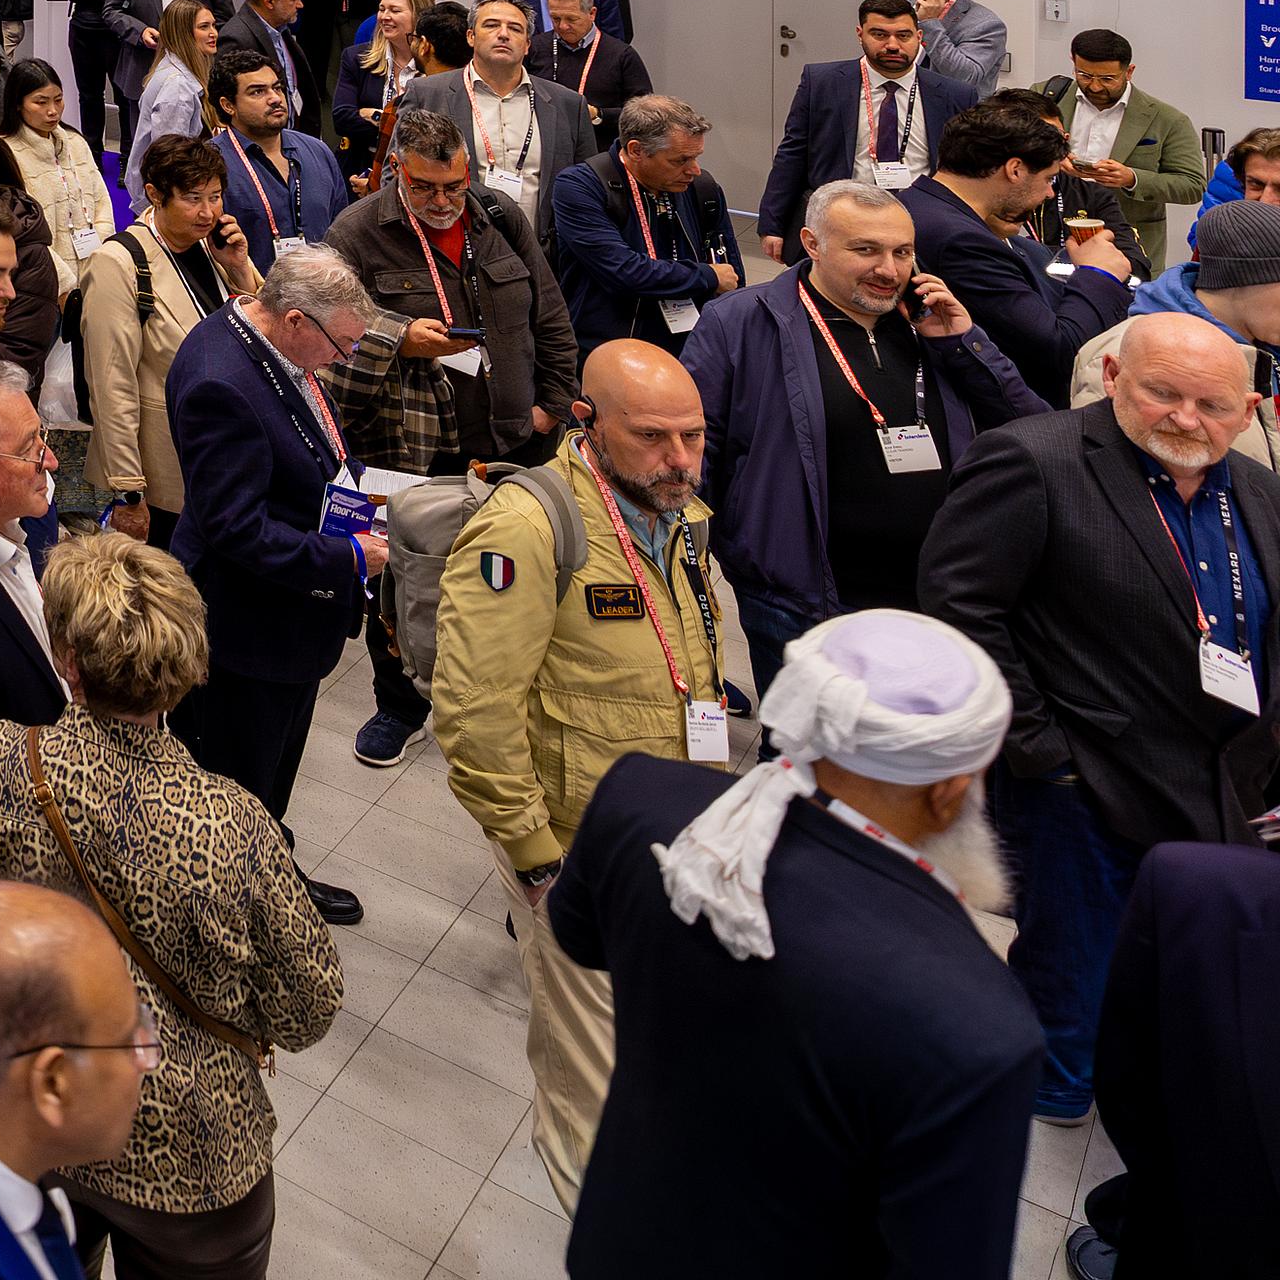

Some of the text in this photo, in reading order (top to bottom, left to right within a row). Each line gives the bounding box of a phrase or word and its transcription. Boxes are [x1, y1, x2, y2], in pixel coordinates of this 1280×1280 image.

[1259, 64, 1272, 73] for
[228, 314, 253, 344] NEXARO
[262, 361, 285, 396] NEXARO
[330, 503, 369, 522] Floor Plan
[1217, 490, 1232, 527] NEXA
[681, 516, 698, 566] NEXARO
[1229, 552, 1243, 600] NEXARO
[601, 606, 635, 615] LEADER
[629, 589, 637, 601] 1
[698, 594, 717, 645] NEXARO
